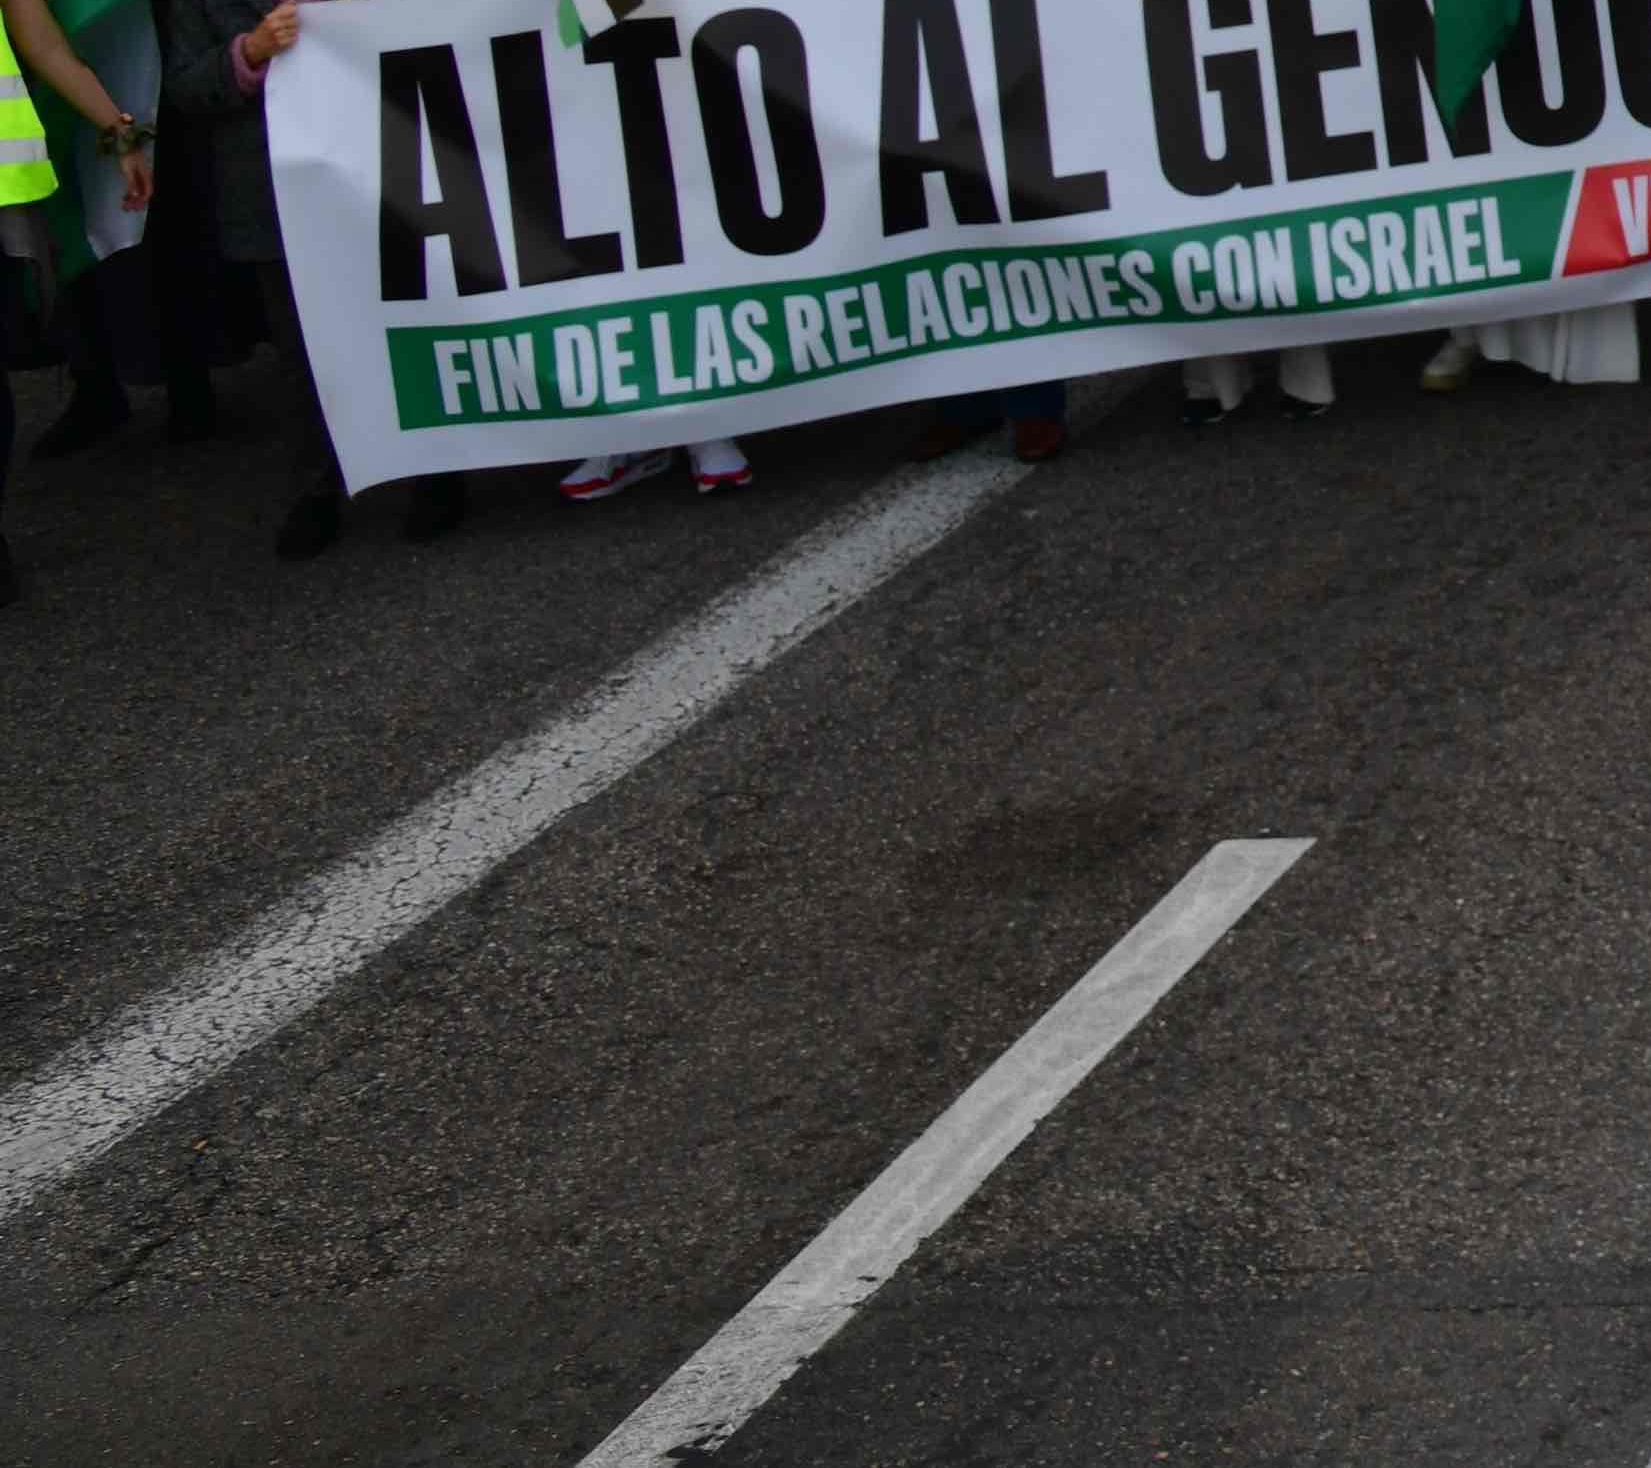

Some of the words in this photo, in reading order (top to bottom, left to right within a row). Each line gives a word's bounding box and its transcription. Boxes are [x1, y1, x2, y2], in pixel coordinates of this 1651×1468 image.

[378, 3, 828, 303] ALTO
[433, 330, 542, 416] FIN
[556, 309, 640, 410] DE
[652, 298, 775, 398] LAS
[790, 243, 1161, 375] RELACIONES
[1172, 229, 1298, 316] CON
[1310, 196, 1520, 305] ISRAEL
